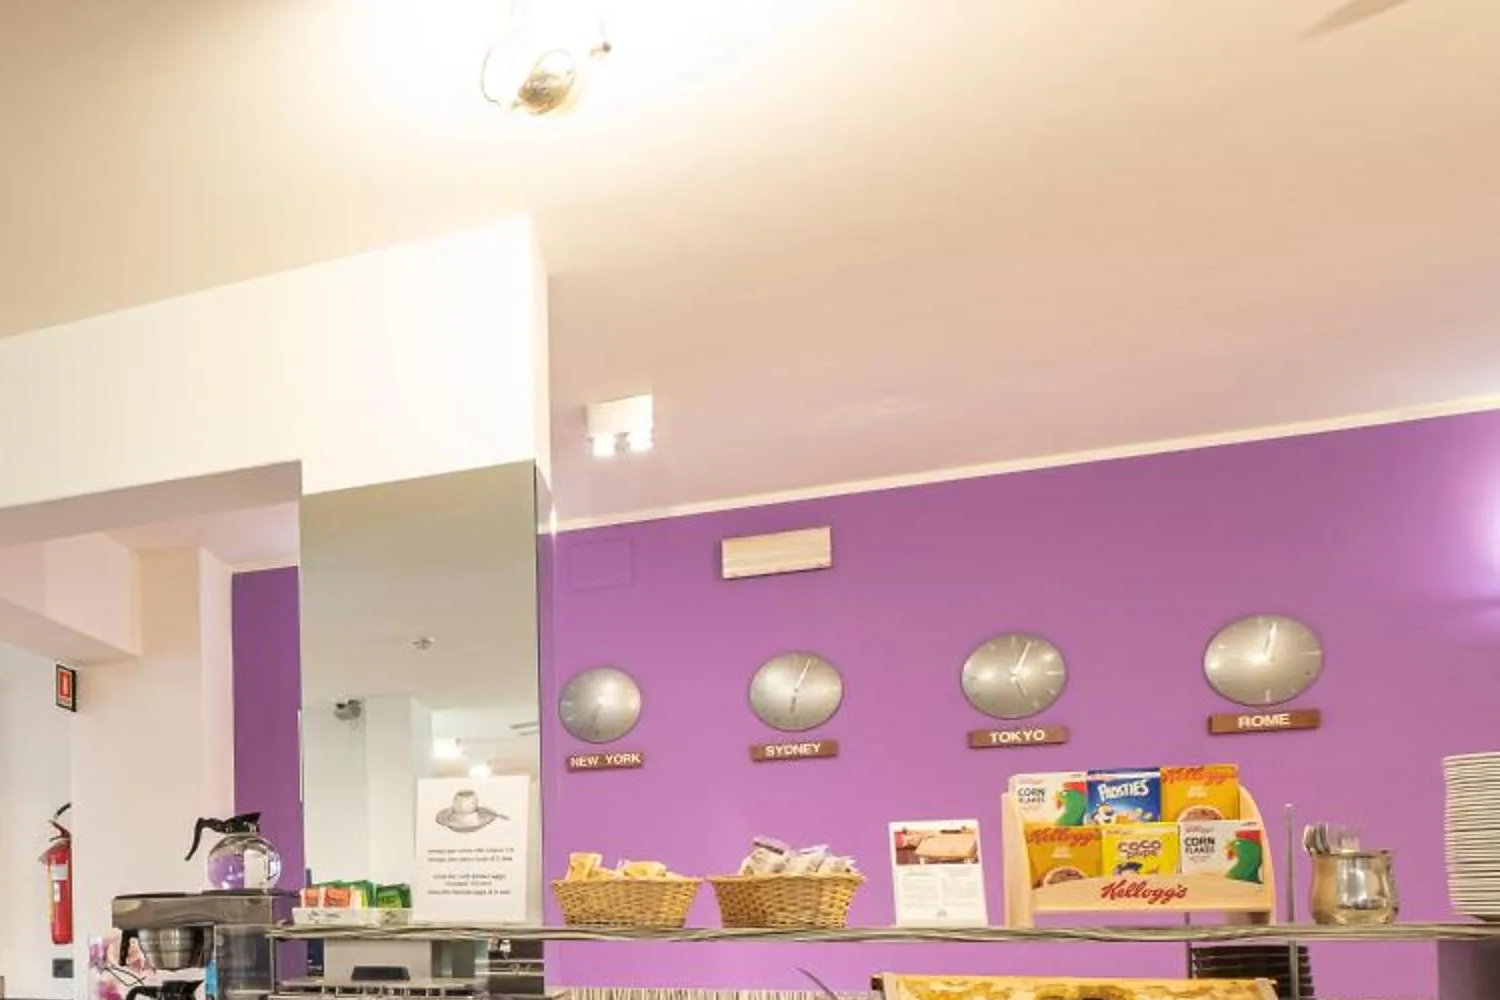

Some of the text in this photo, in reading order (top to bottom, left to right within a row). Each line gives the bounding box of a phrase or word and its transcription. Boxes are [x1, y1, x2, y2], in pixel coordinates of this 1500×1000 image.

[1237, 713, 1292, 729] ROME
[988, 728, 1046, 744] TOKYO
[765, 742, 821, 757] SYDNEY
[570, 752, 642, 768] NEW YORK
[1018, 787, 1045, 797] CORN
[1117, 839, 1162, 852] COCO
[1184, 837, 1215, 847] CORN
[1100, 879, 1188, 904] Kellogg's
